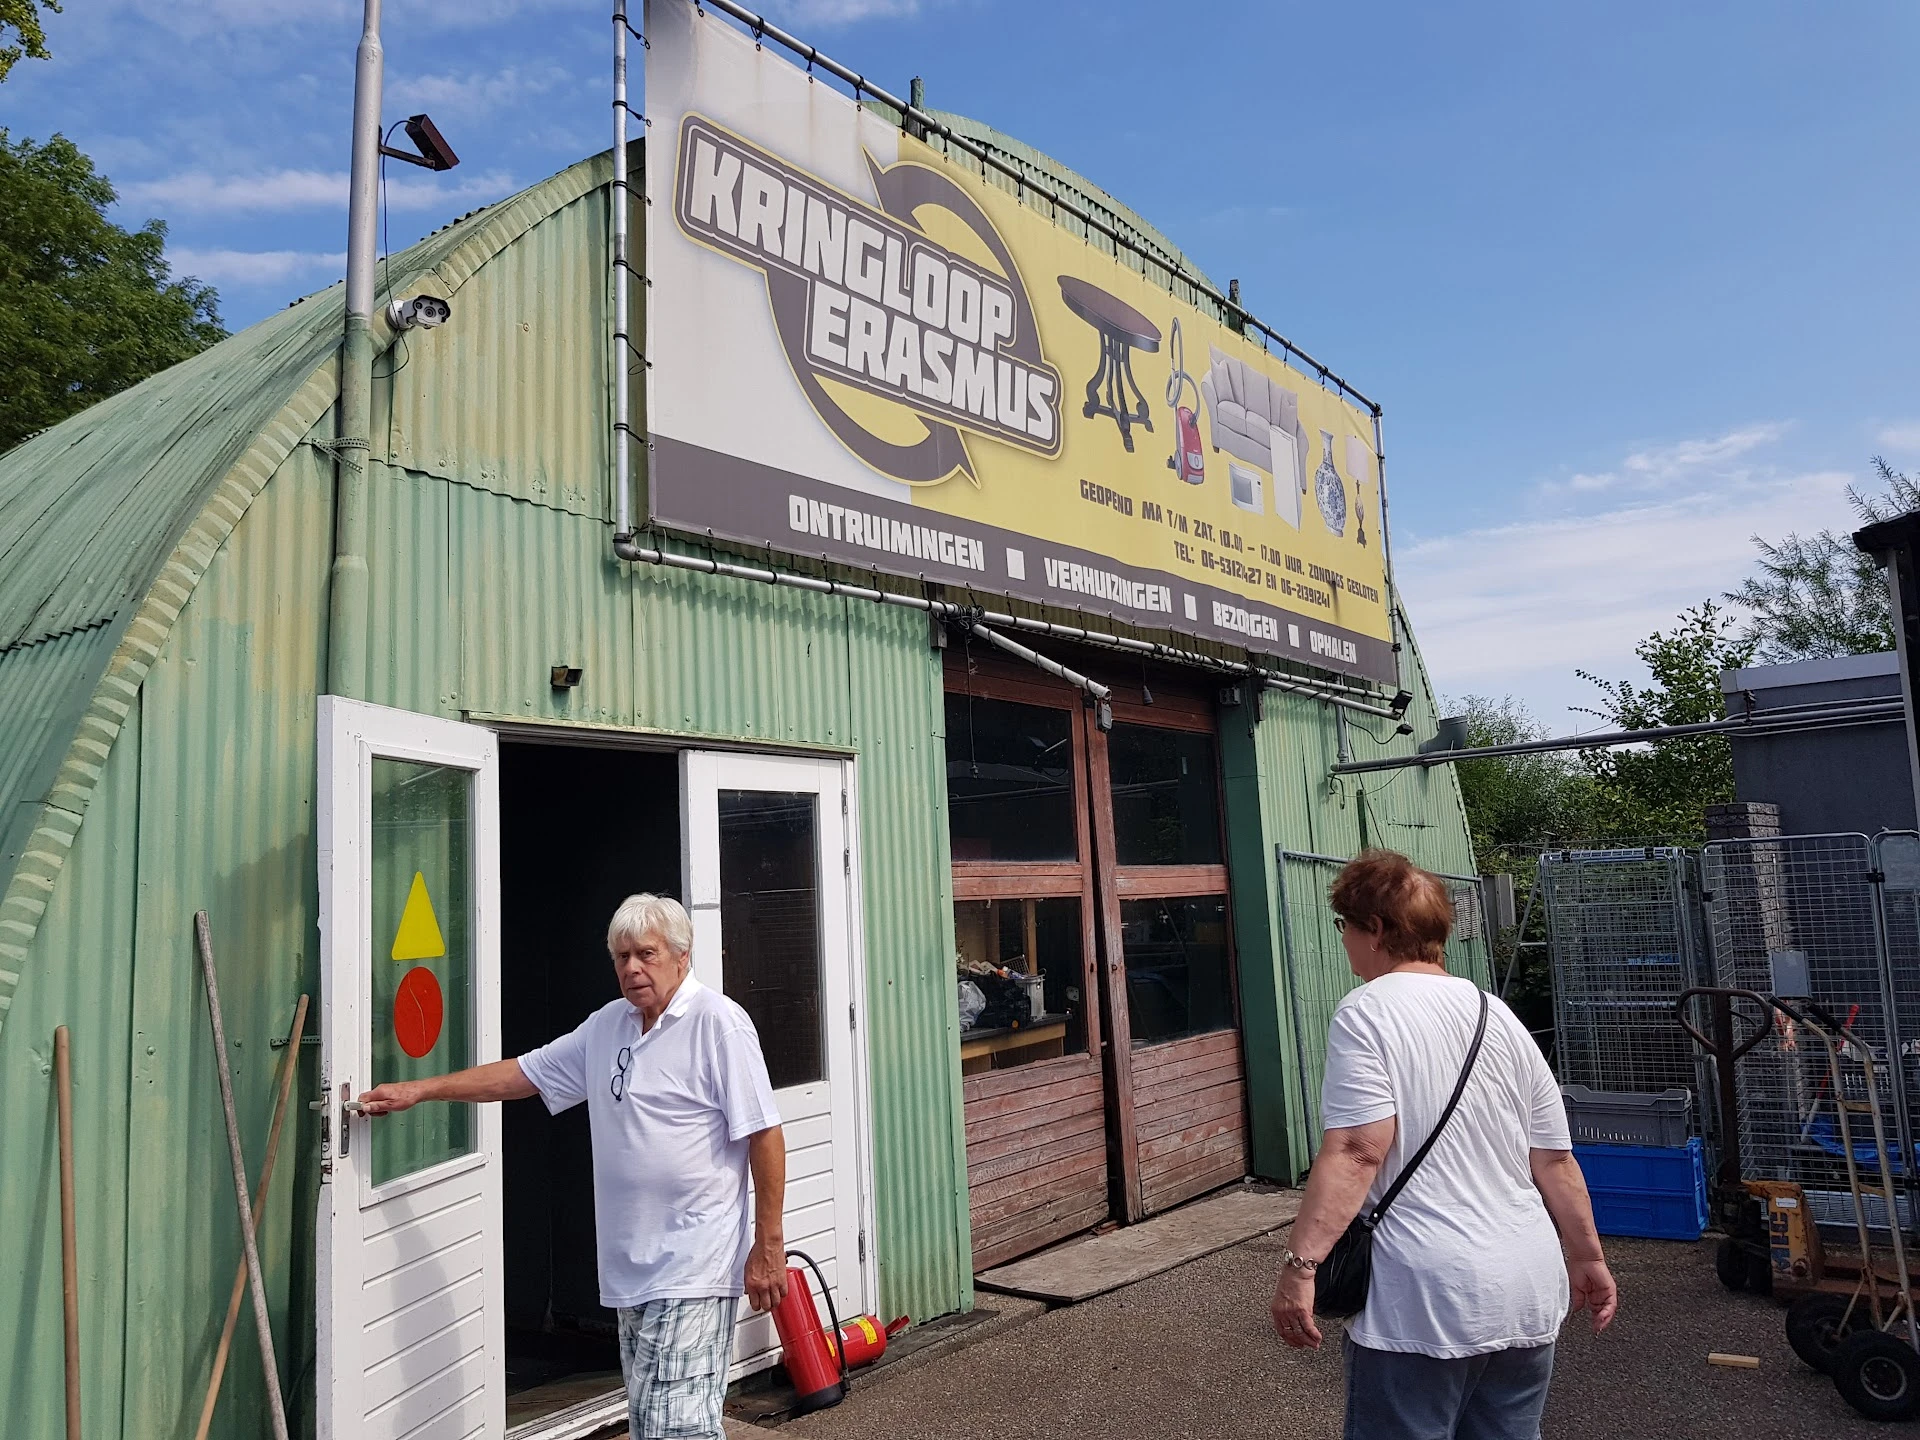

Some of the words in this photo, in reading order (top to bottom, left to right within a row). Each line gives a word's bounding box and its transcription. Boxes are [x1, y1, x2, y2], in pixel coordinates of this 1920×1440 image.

[691, 137, 1012, 352] KRINGLOOP
[811, 282, 1053, 441] ERASMUS
[788, 494, 985, 572] ONTRUIMINGEN
[1044, 557, 1172, 614] VERHUIZINGEN
[1211, 600, 1279, 643] BEZORGEN
[1309, 630, 1357, 664] OPHALEN
[1080, 479, 1133, 516] GEOPEND
[1142, 501, 1163, 523] MA
[1167, 509, 1188, 534] T/M
[1193, 519, 1216, 543] ZAT.
[1219, 529, 1243, 554] 10.00
[1260, 544, 1281, 567] 17.00
[1285, 554, 1305, 576] UUR.
[1308, 562, 1344, 590] ZONDAGS
[1346, 577, 1379, 604] GESLOTEN
[1174, 540, 1195, 564] TEL:
[1265, 571, 1277, 591] EN
[1280, 577, 1330, 609] 06-21391241
